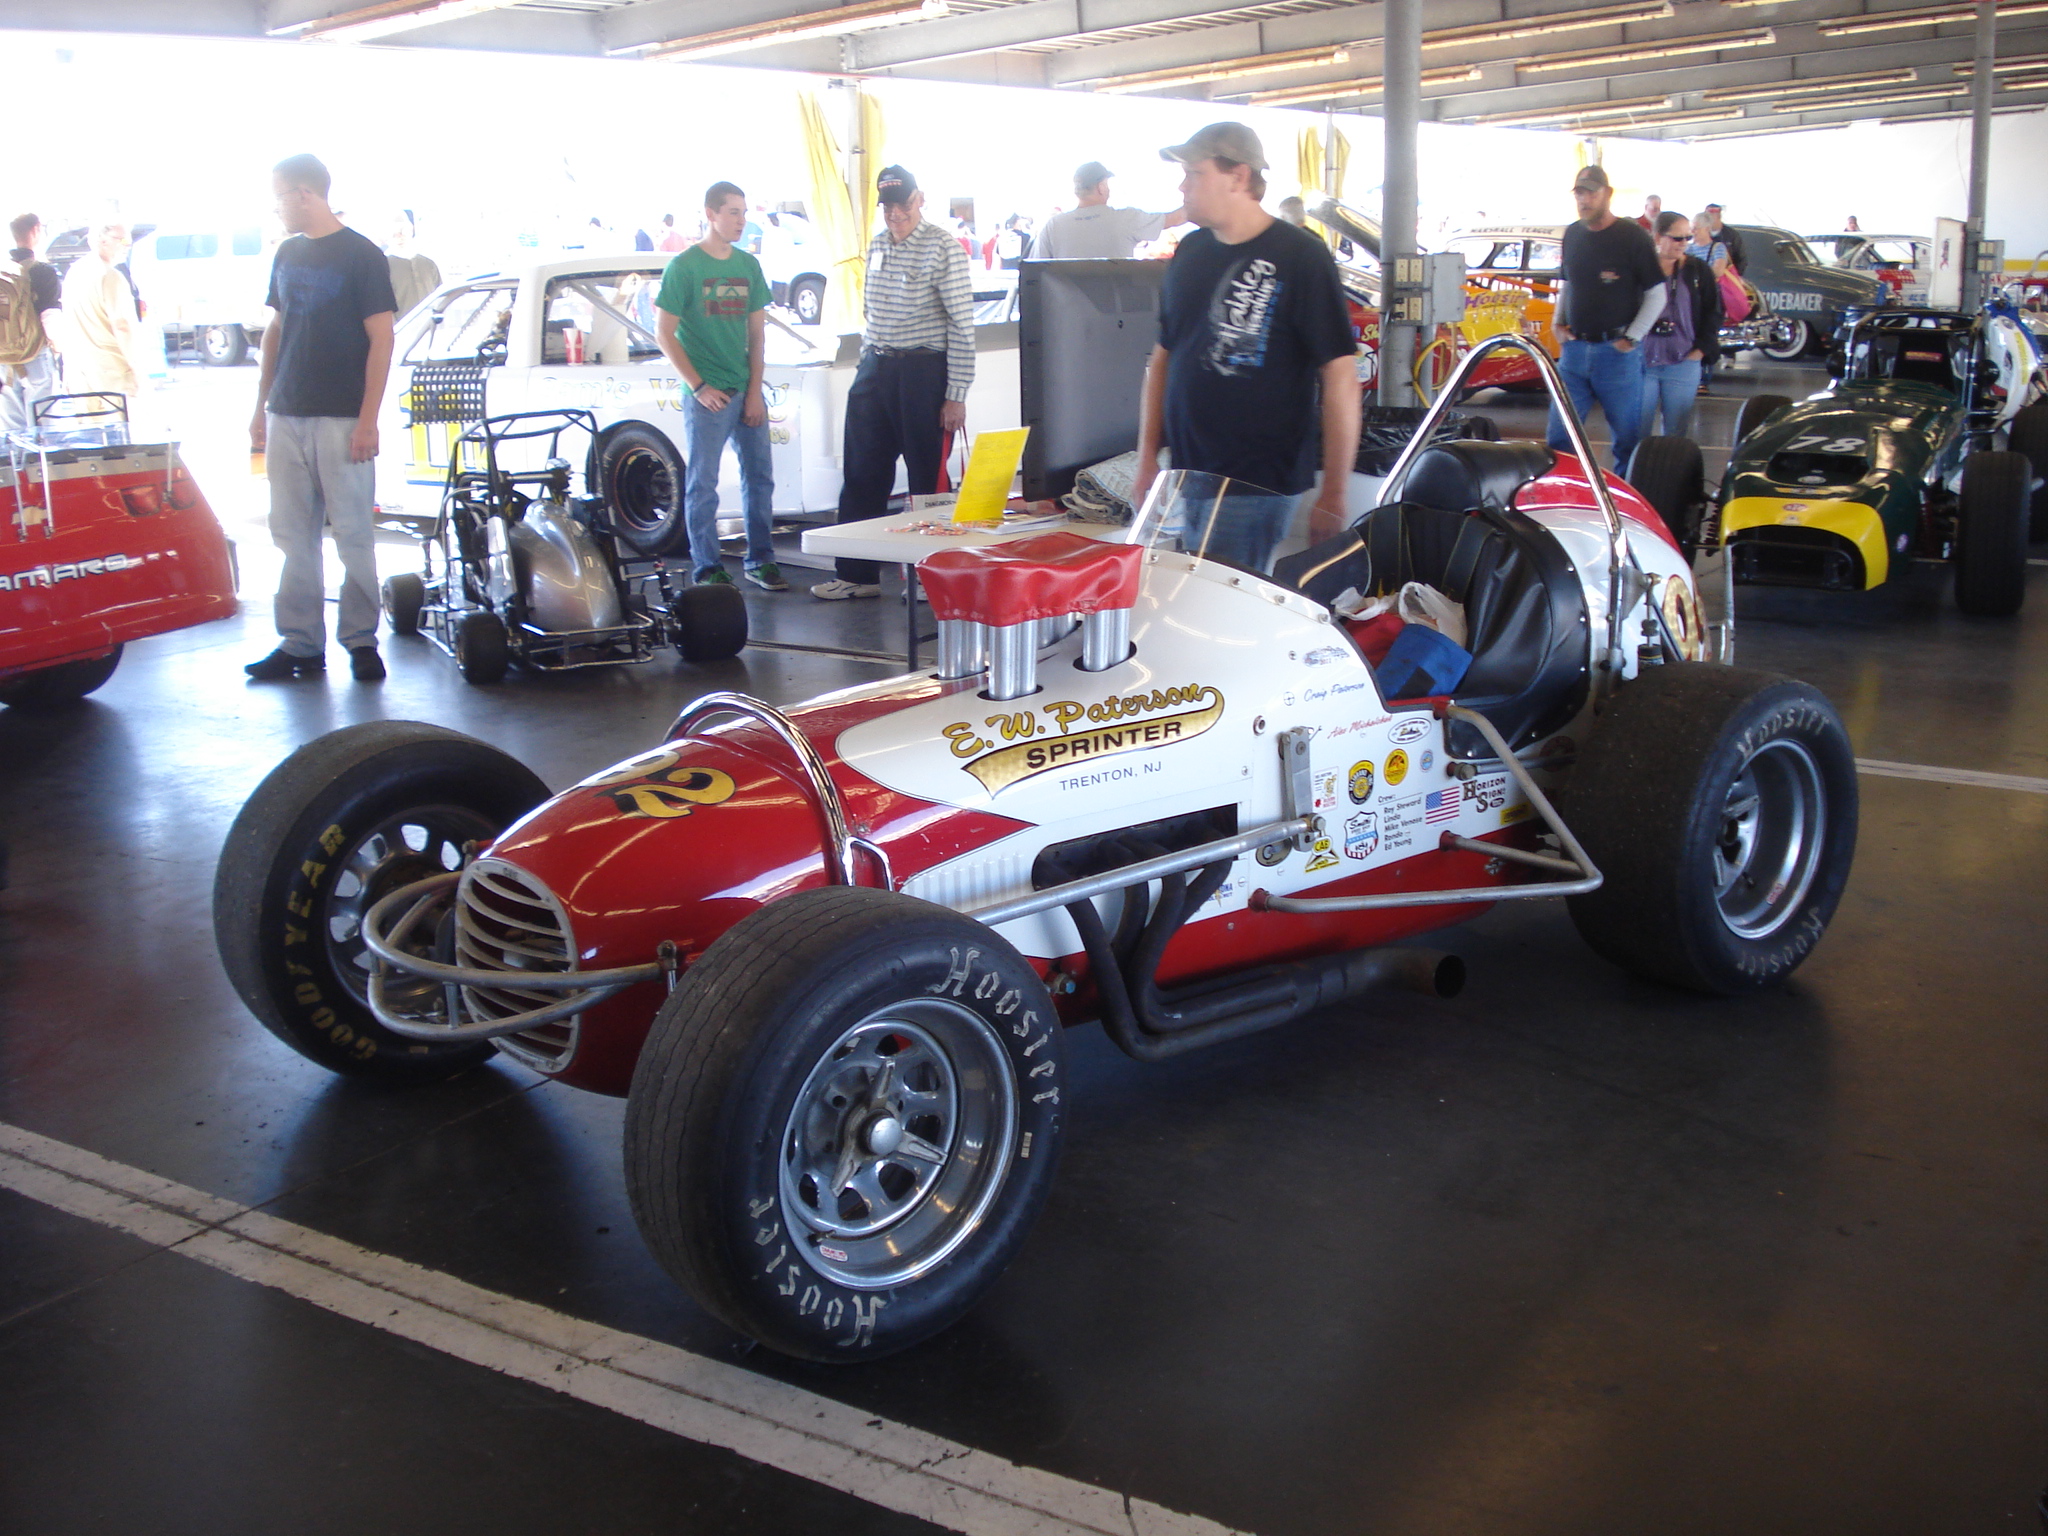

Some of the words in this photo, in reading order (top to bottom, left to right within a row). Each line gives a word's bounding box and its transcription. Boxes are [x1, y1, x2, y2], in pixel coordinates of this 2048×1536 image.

[1763, 291, 1824, 313] DEBAKER
[1785, 435, 1866, 453] 78
[0, 553, 129, 592] AMARO
[1043, 683, 1201, 735] Paterson
[1026, 721, 1182, 769] SPRINTER
[1058, 767, 1138, 792] TRENTON,
[1143, 760, 1163, 774] NJ
